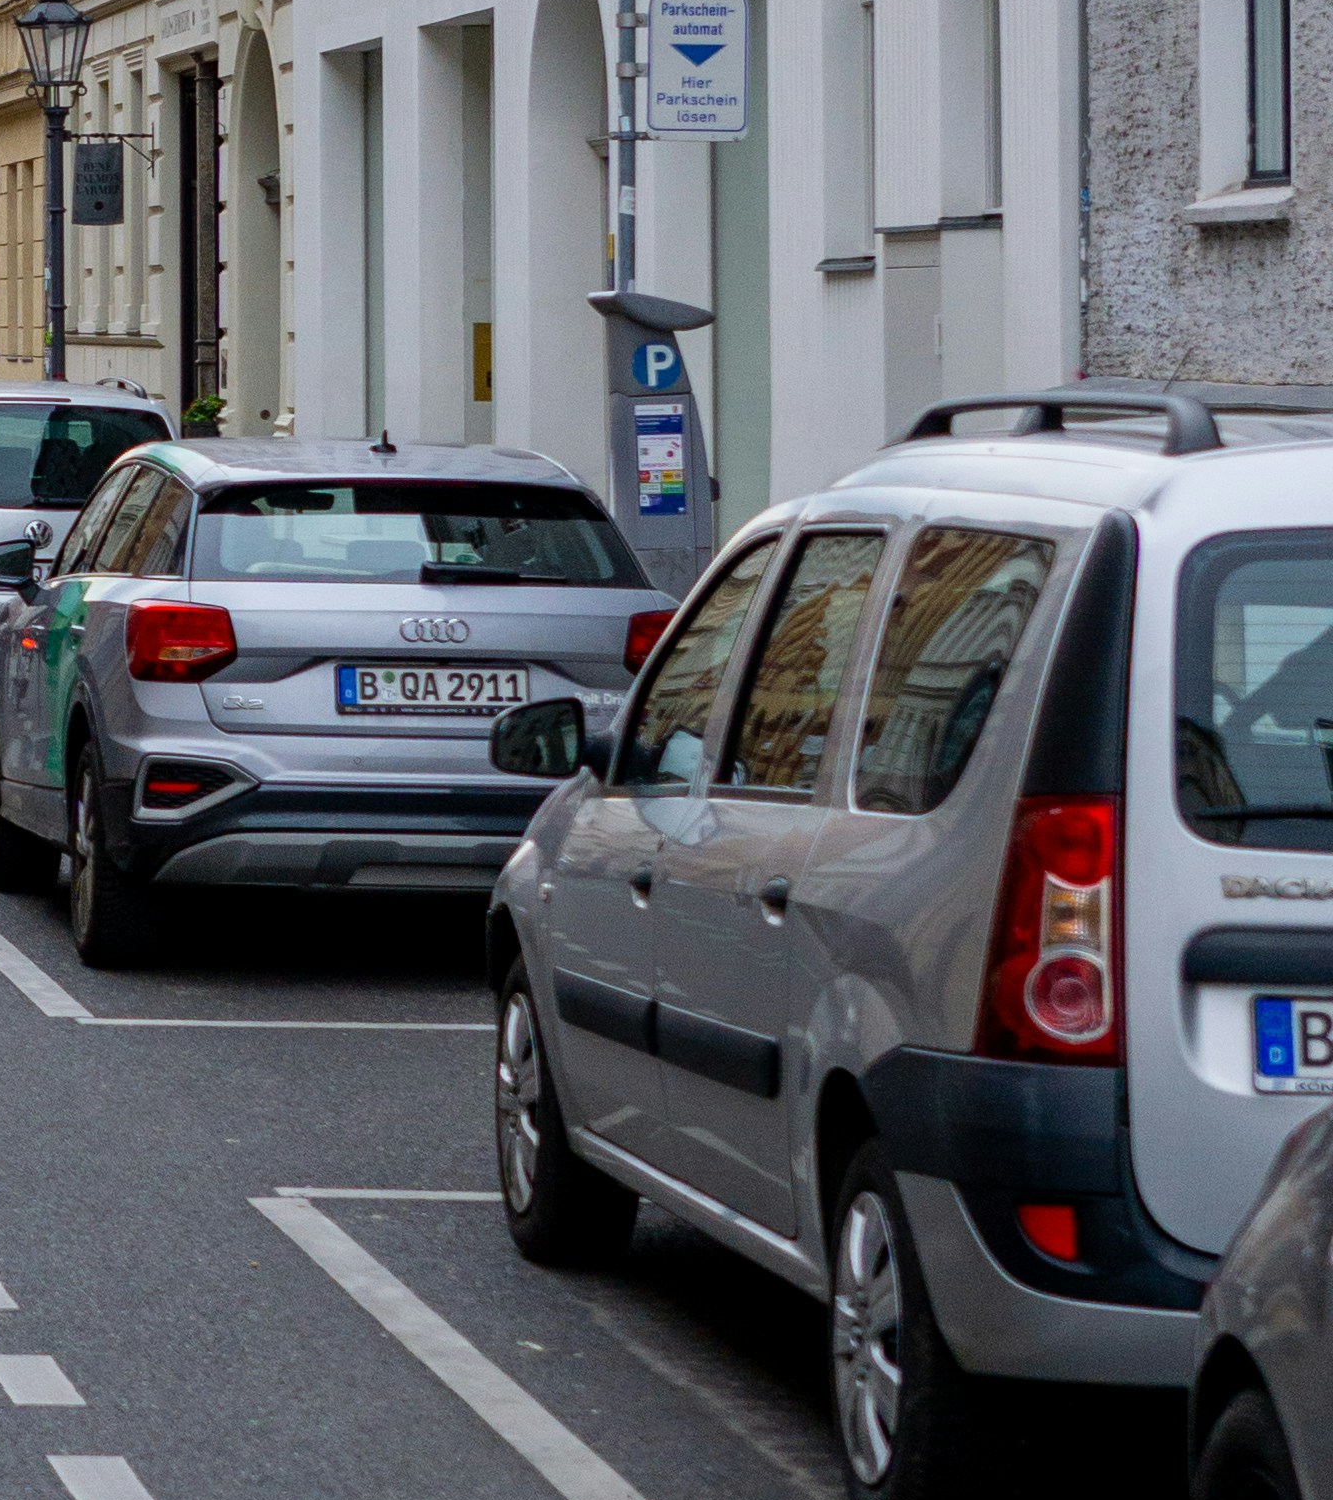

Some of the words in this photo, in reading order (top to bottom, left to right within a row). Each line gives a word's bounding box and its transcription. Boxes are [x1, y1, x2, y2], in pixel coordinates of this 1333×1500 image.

[661, 2, 735, 17] Parkschein-
[672, 23, 724, 37] automat
[681, 77, 713, 90] Hier
[656, 93, 738, 107] Parkschein
[676, 110, 717, 124] lösen
[645, 344, 676, 388] P
[359, 672, 379, 701] B
[400, 672, 440, 701] QA
[447, 673, 523, 702] 2911
[1299, 1011, 1333, 1068] B
